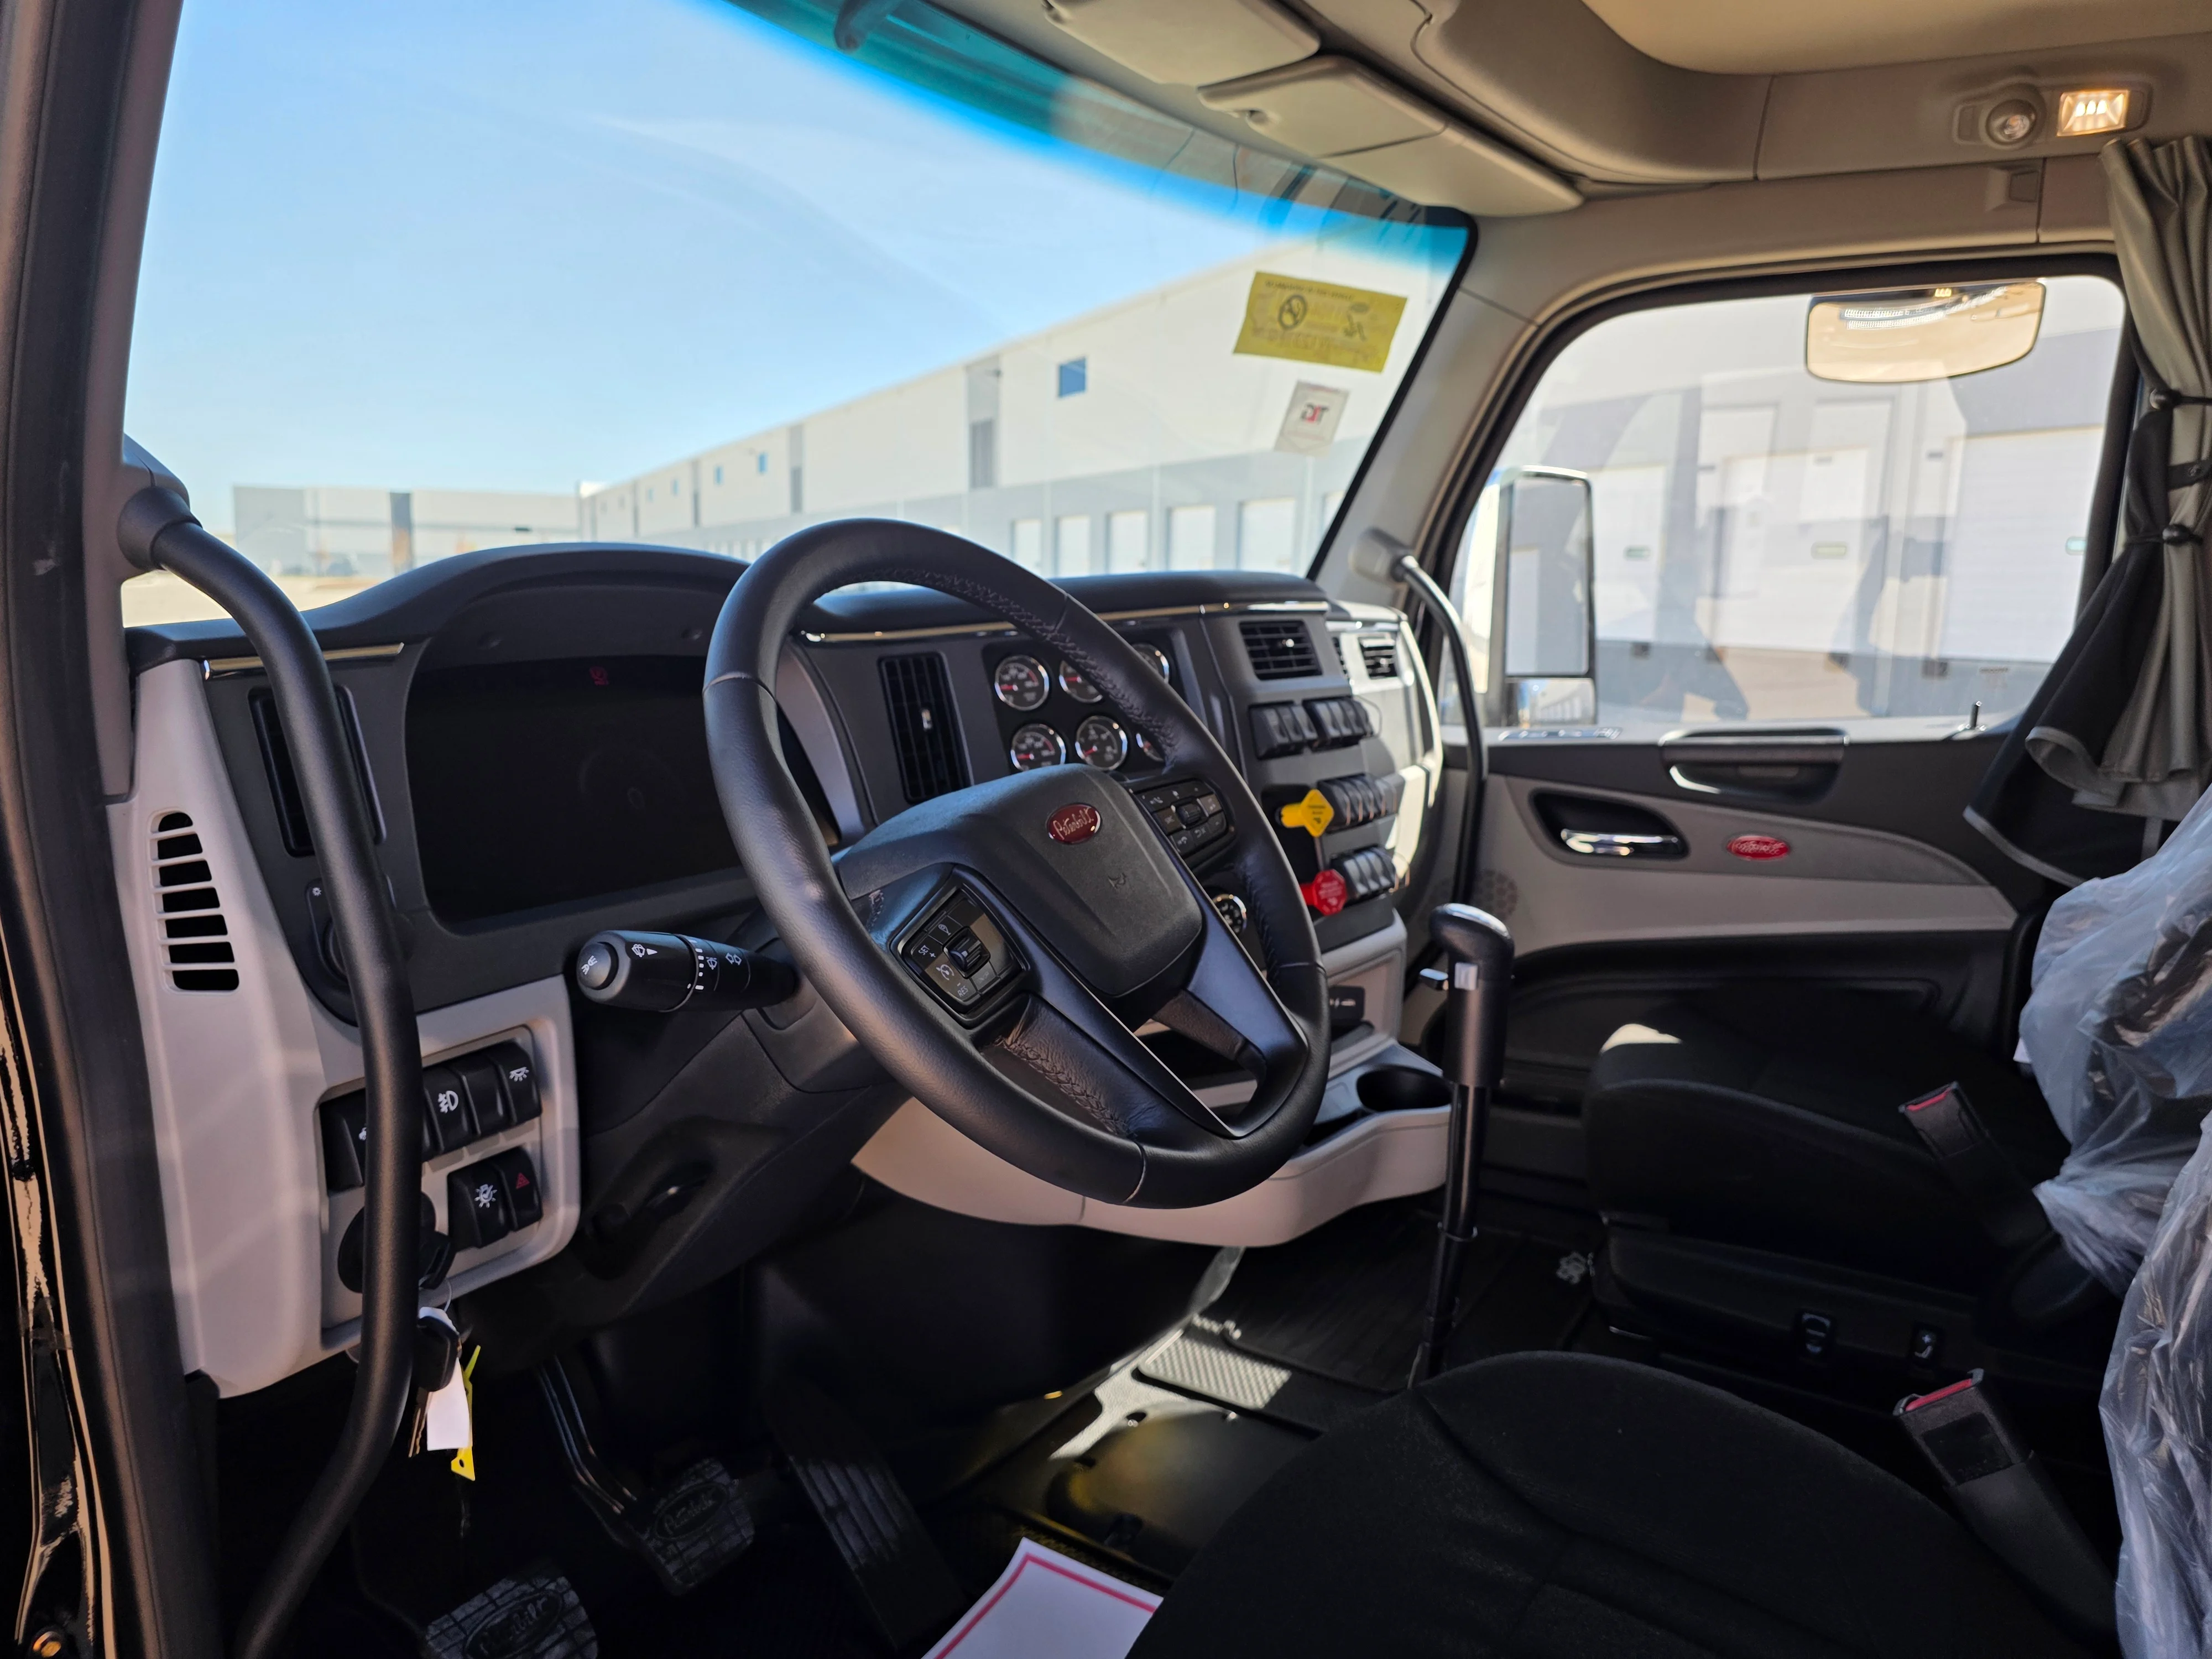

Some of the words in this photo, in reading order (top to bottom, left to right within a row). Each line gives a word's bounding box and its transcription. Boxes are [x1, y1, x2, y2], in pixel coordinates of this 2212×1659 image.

[1053, 807, 1094, 840] Peterbilt
[918, 945, 930, 956] SET
[957, 985, 968, 997] RES
